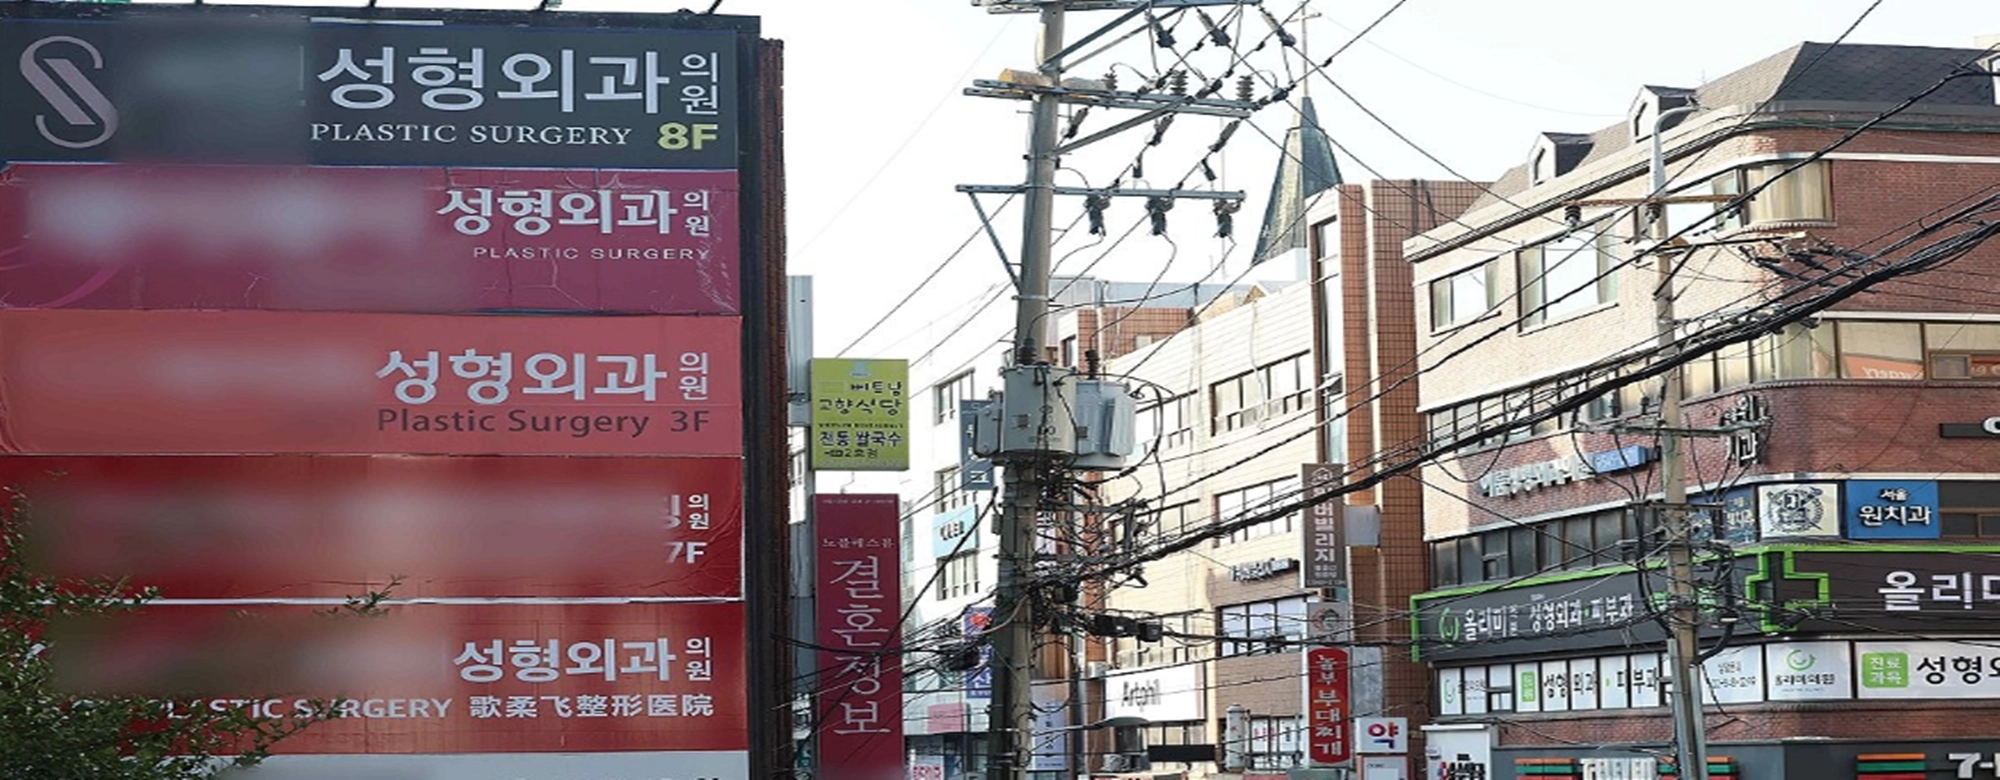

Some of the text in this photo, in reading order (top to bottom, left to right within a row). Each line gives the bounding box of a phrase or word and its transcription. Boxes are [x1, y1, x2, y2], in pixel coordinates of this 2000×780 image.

[317, 46, 670, 114] 성형외과
[680, 52, 719, 115] 의원
[310, 122, 719, 150] PLASTIC SURGERY 8F
[436, 188, 678, 236] 성형외과
[684, 190, 711, 237] 의원
[473, 247, 710, 260] PLASTIC SURGERY
[375, 348, 668, 405] 성형외과
[679, 352, 708, 401] 의원
[378, 409, 709, 438] Plastic Surgery 3F
[819, 398, 902, 416] 고향식당
[855, 431, 902, 448] 쌀국수
[687, 493, 710, 530] 의원
[1880, 488, 1908, 501] 서울
[1859, 505, 1932, 527] 원치과
[663, 541, 708, 564] 7F
[1463, 606, 1507, 642] 올리미
[453, 637, 676, 682] 성형외과
[684, 637, 712, 682] 의원
[829, 554, 892, 736] 결혼정보
[469, 694, 714, 718] 歌柔飞整形医院
[1313, 689, 1343, 757] 부대찌개
[1367, 721, 1399, 750] 약
